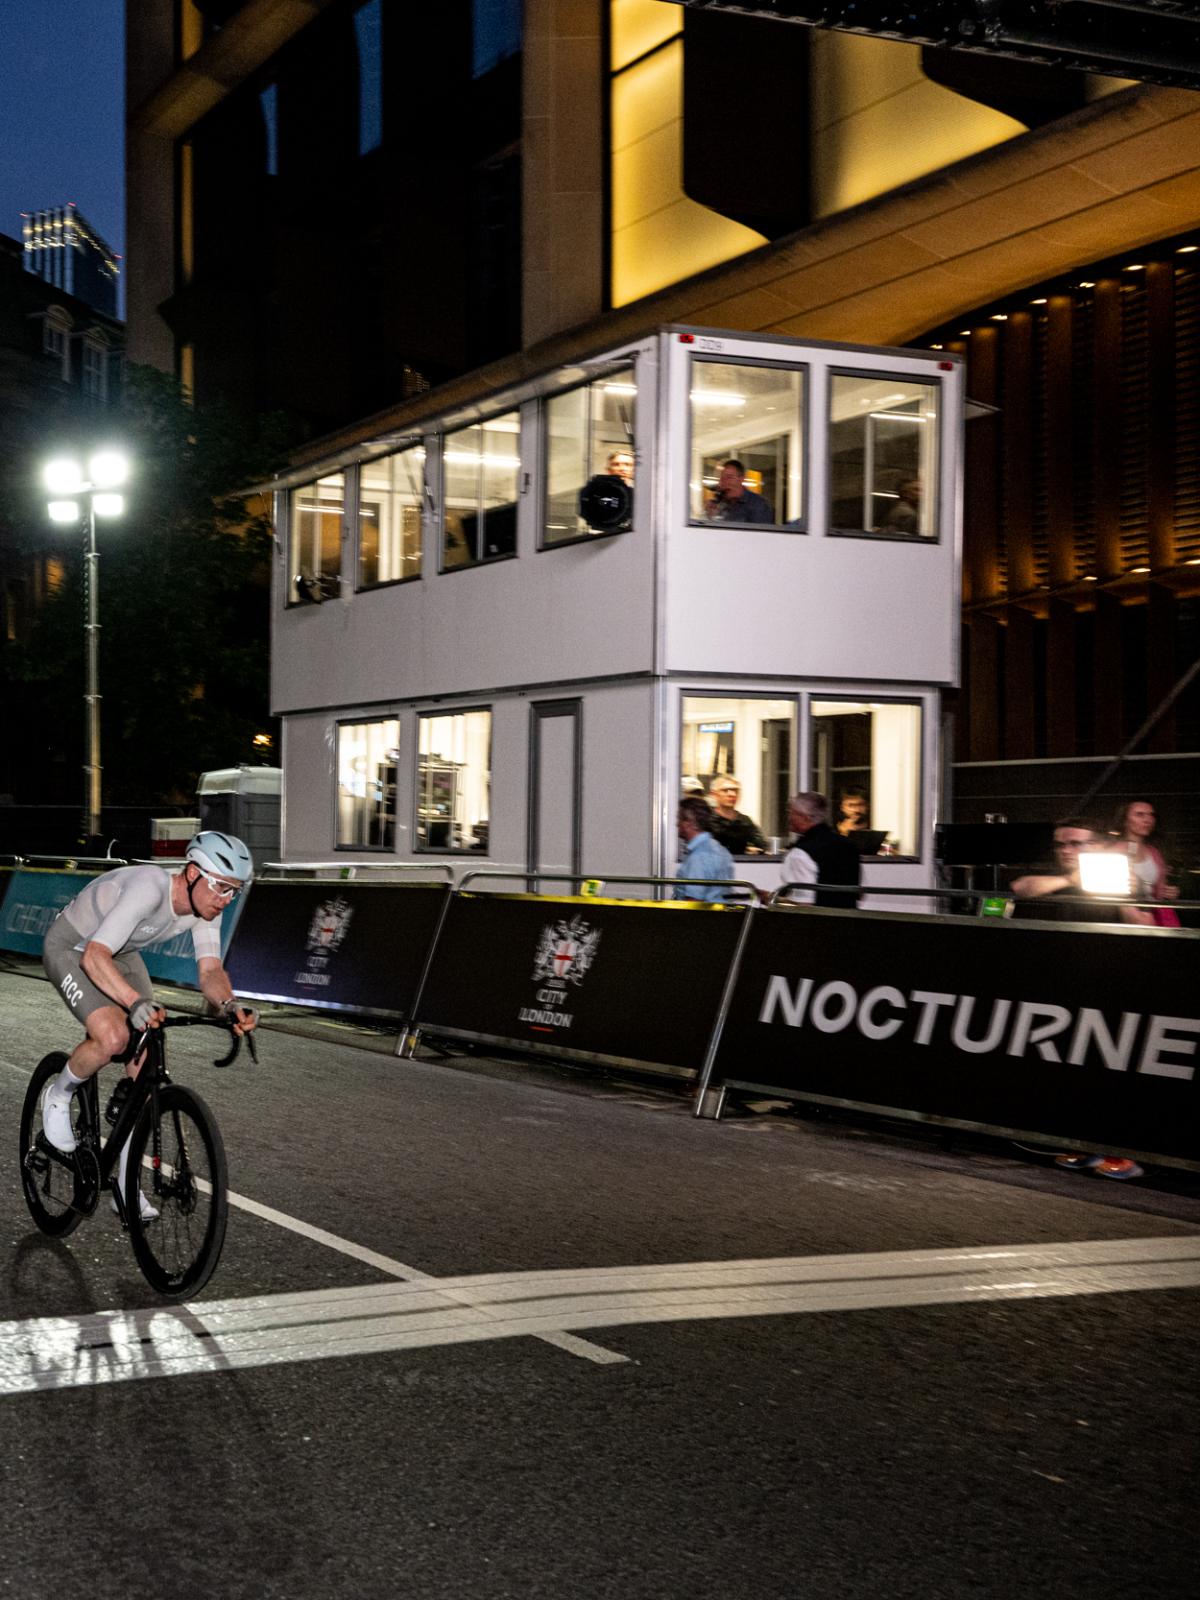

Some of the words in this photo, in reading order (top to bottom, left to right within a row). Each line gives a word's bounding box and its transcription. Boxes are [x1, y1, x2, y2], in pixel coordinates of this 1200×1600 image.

[60, 972, 84, 1008] RCC
[535, 988, 568, 1005] CITY
[517, 1007, 574, 1028] LONDON
[758, 974, 1200, 1081] NOCTURNE
